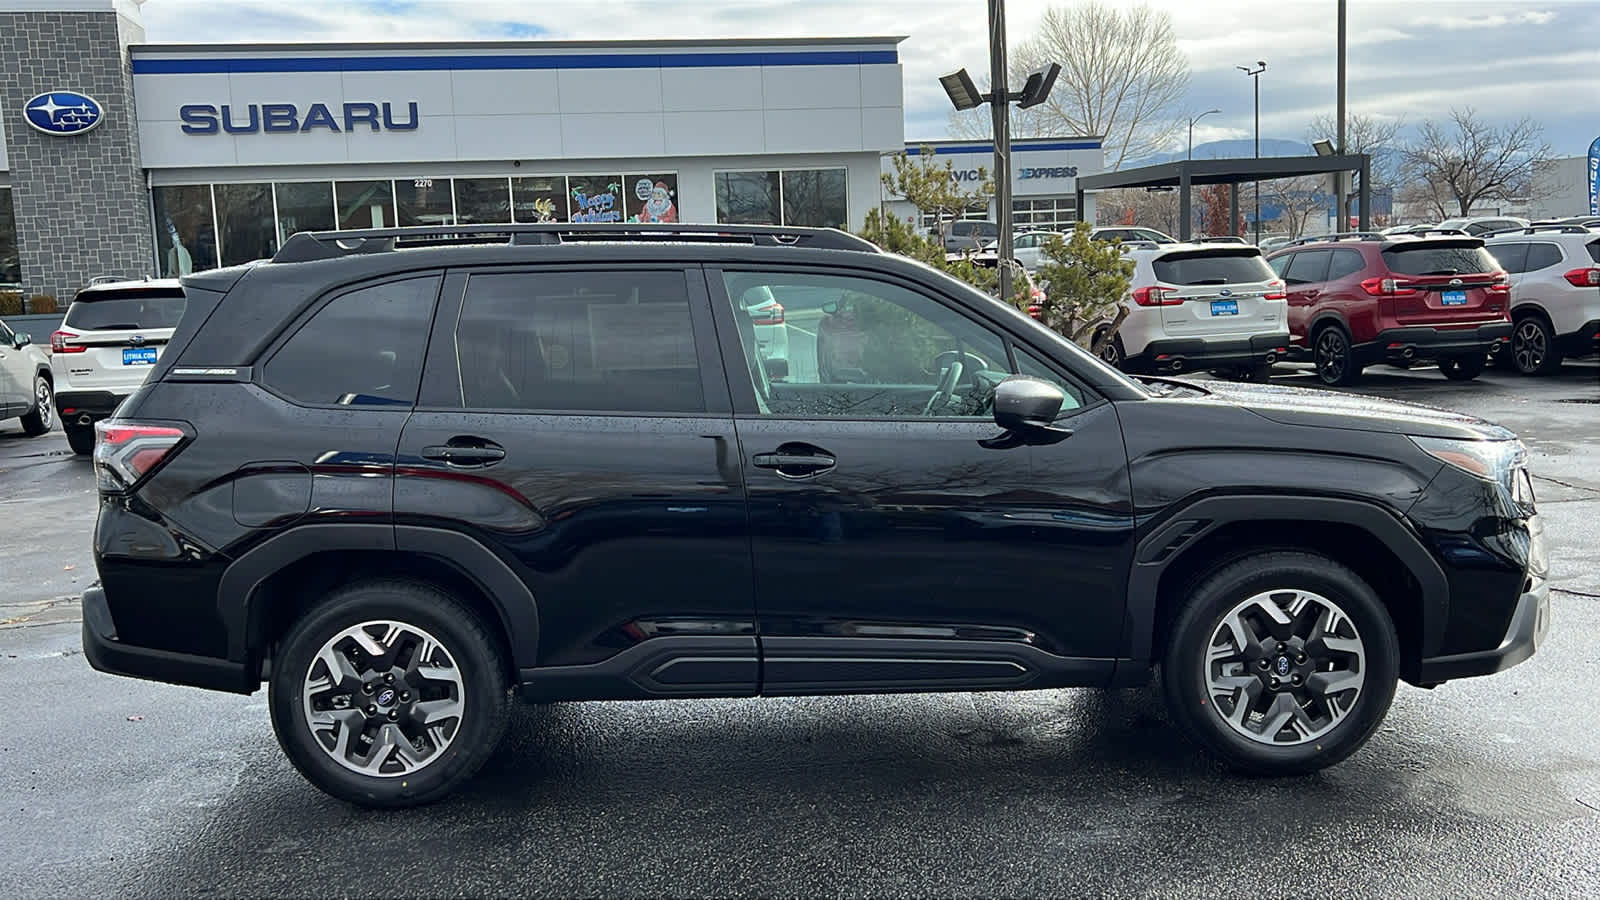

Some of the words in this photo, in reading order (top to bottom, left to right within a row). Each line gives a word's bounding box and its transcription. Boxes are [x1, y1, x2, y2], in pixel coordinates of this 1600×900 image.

[179, 102, 418, 134] SUBARU
[1021, 167, 1077, 179] EXPRESS
[414, 179, 433, 188] 2270
[575, 193, 615, 210] Happy
[123, 351, 156, 361] LITHIA.COM
